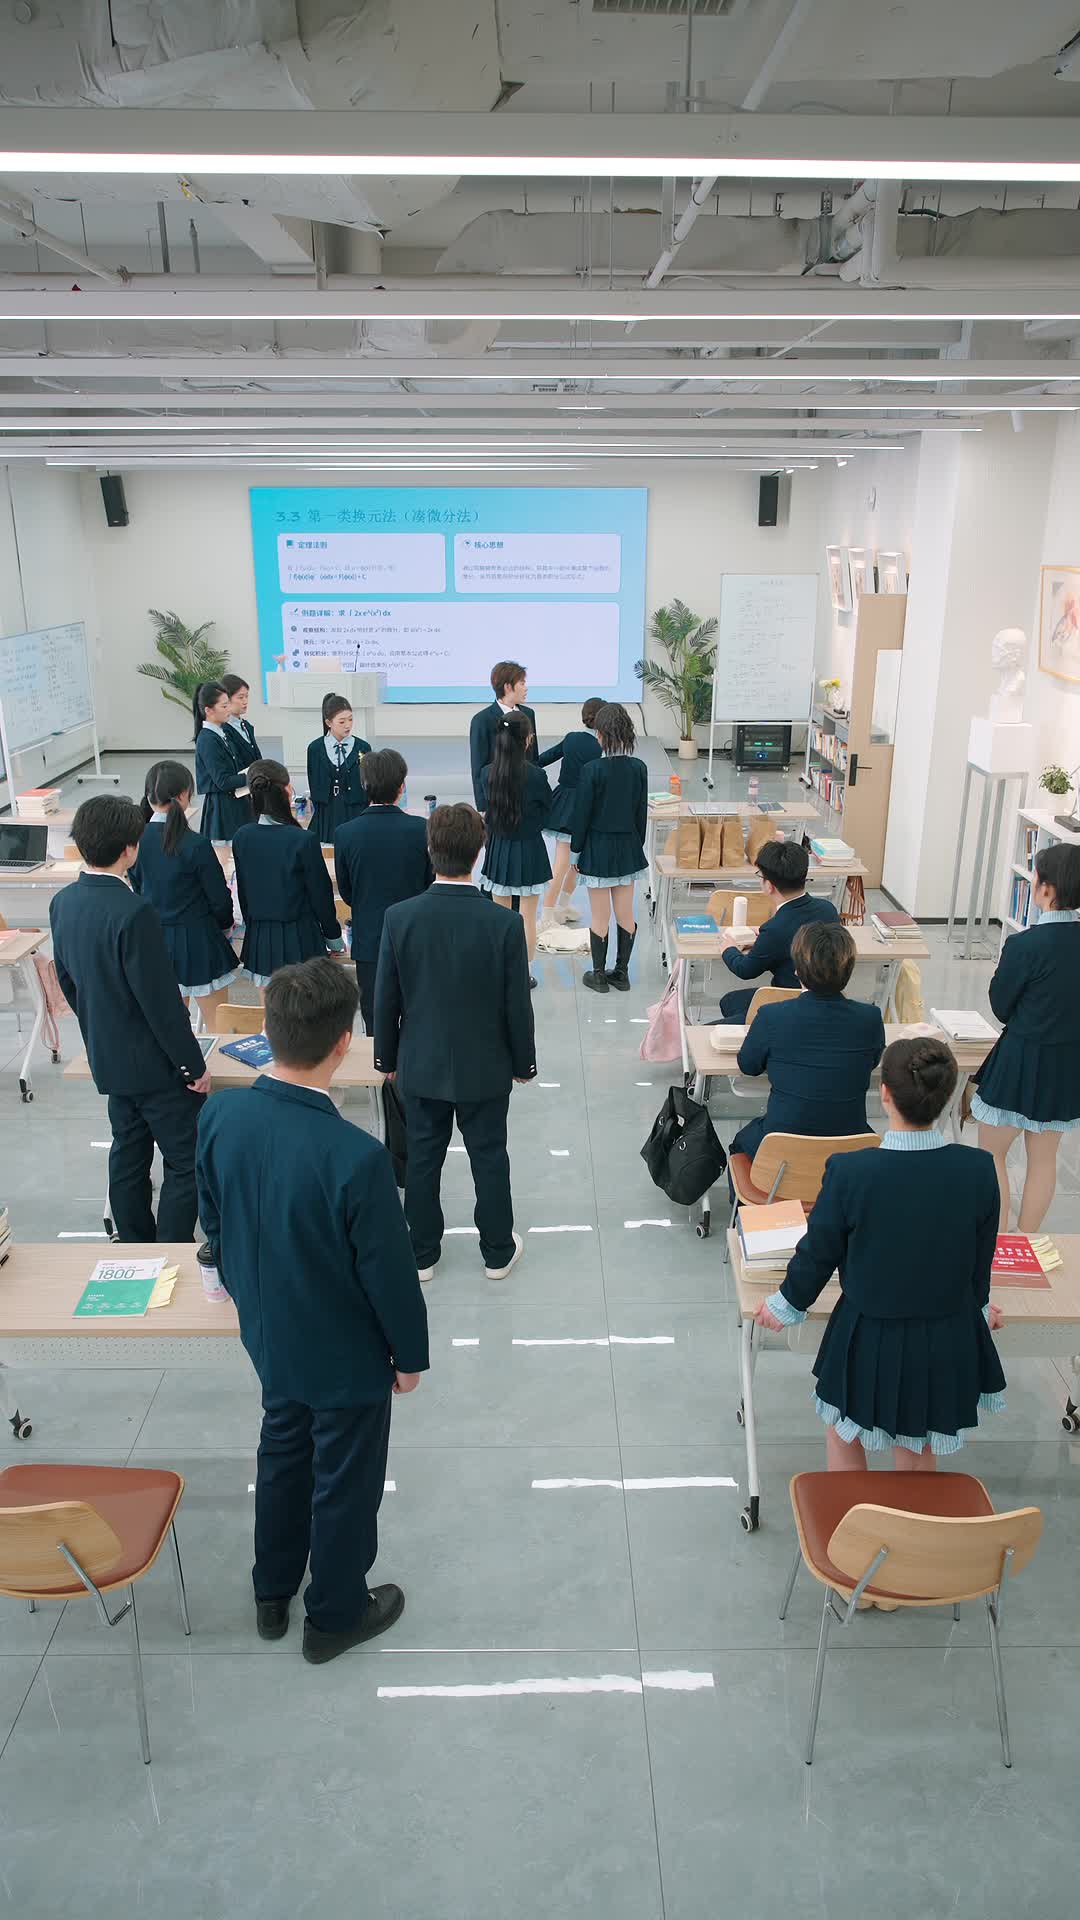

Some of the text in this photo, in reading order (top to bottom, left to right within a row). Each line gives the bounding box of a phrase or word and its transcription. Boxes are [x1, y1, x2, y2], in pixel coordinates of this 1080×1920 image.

[274, 508, 482, 524] 3.3 第一类换元法（凑微分法）
[474, 541, 504, 549] 核心思想
[98, 1269, 136, 1279] 1800
